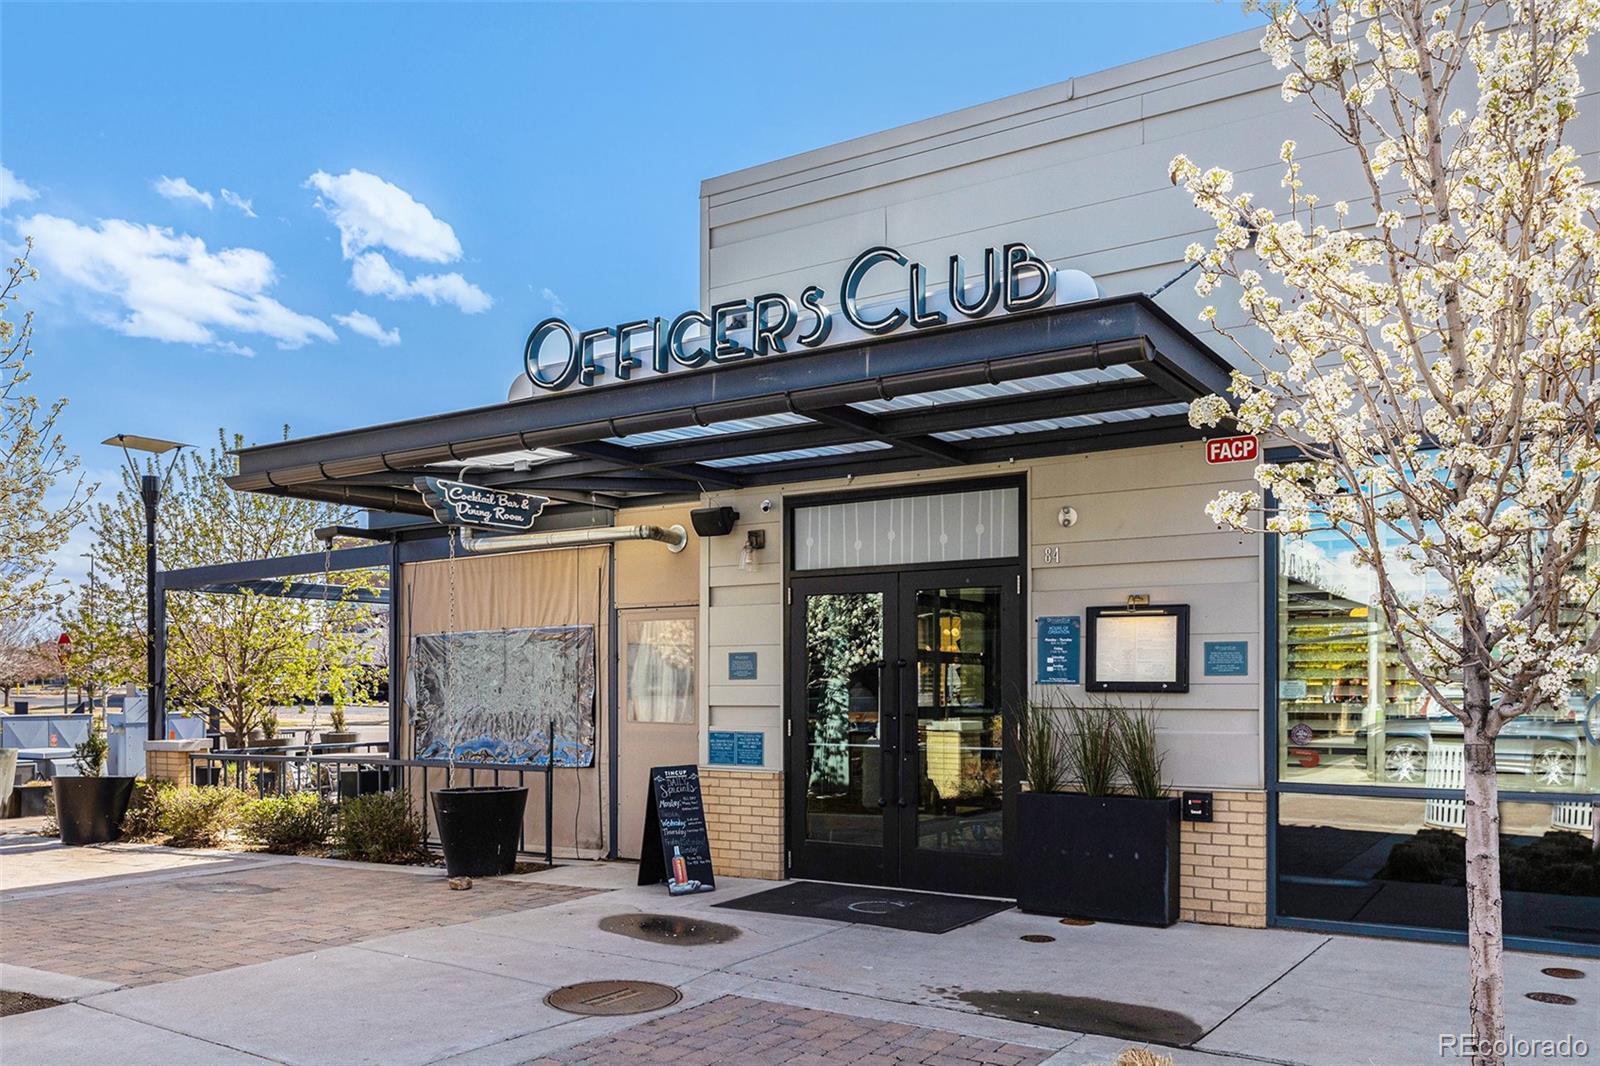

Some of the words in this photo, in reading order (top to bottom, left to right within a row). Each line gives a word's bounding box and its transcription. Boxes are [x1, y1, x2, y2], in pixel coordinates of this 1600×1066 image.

[1210, 440, 1255, 460] FACP
[449, 487, 497, 505] Cocktail
[497, 494, 520, 509] Bar
[521, 499, 530, 510] &
[457, 502, 492, 522] Dining
[493, 507, 525, 522] Room
[1044, 546, 1061, 564] 84
